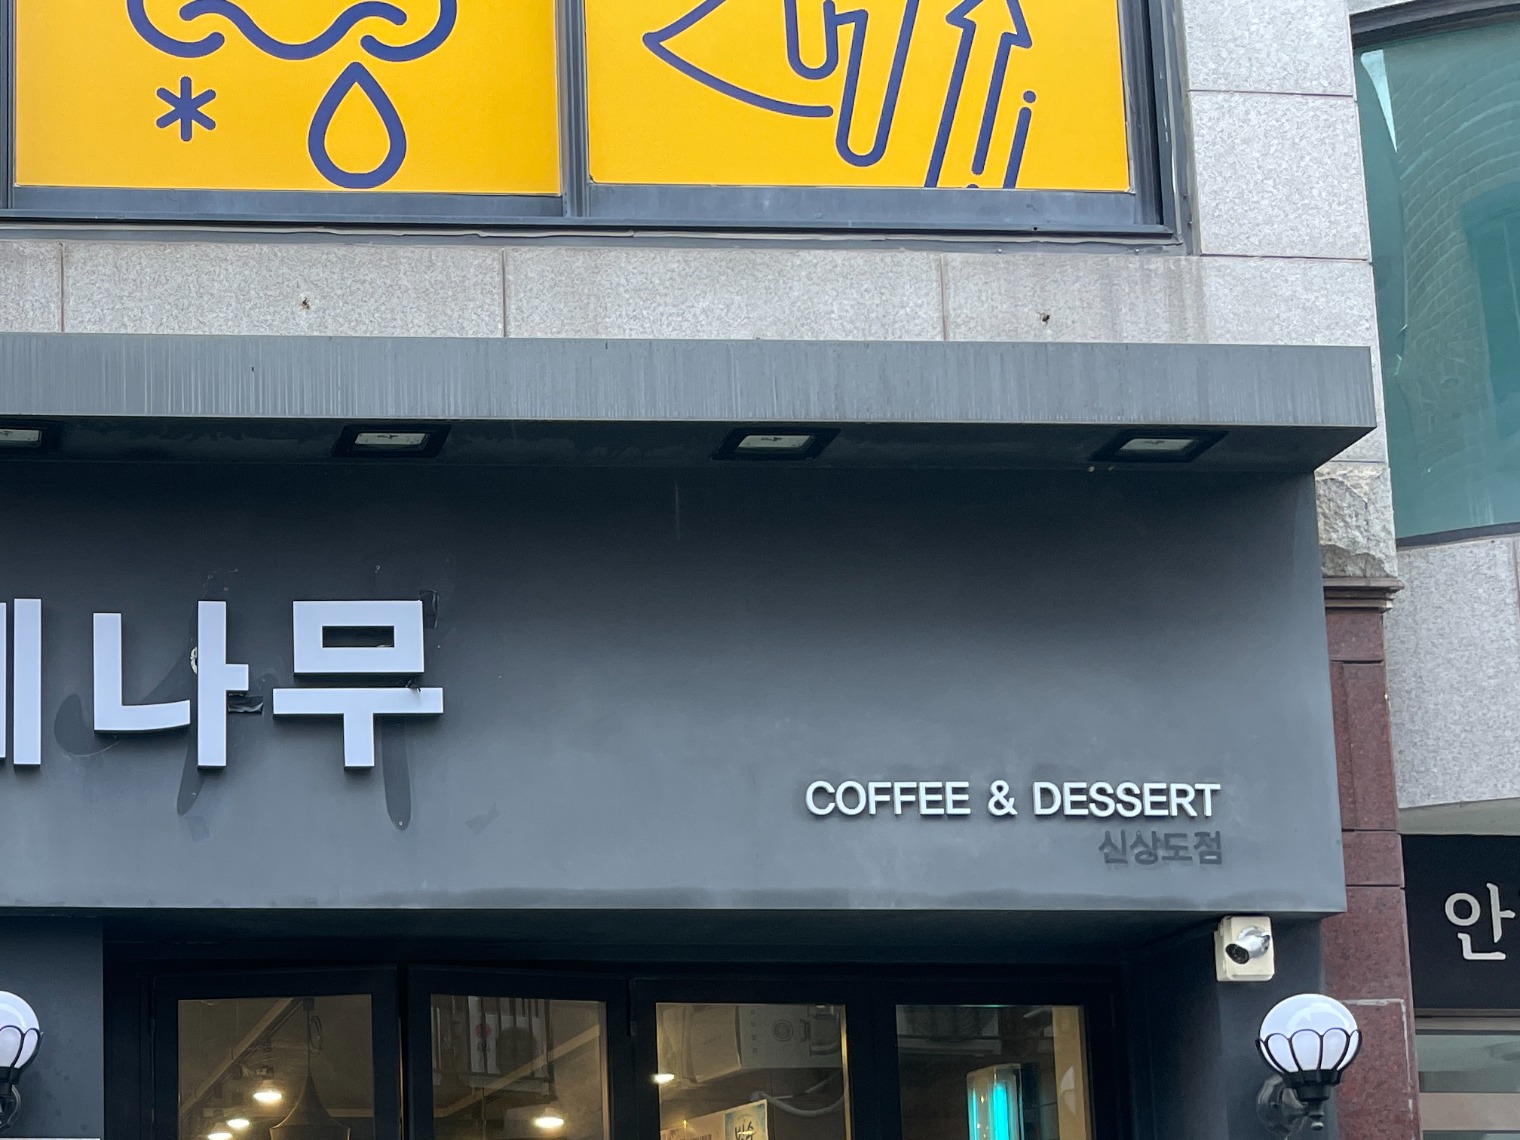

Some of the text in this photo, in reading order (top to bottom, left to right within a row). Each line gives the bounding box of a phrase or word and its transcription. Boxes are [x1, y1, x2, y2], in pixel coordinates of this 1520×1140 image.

[805, 780, 1221, 817] COFFEE & DESSERT
[1098, 830, 1223, 865] 신상도점
